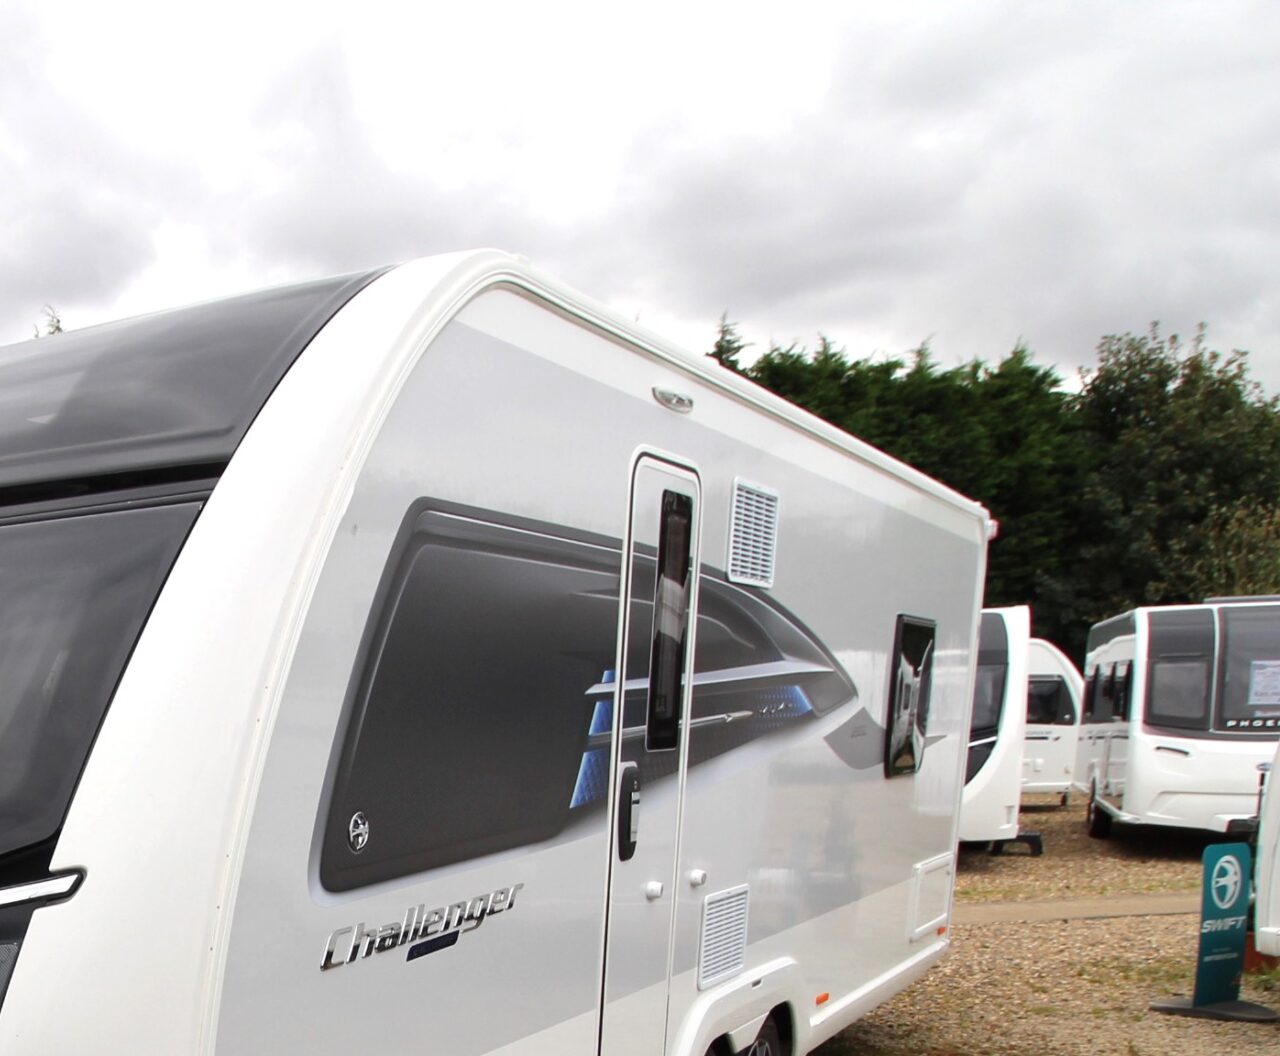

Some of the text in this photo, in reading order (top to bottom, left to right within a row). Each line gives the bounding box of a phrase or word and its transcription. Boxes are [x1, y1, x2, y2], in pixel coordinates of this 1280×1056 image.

[1226, 720, 1280, 728] PHOE
[320, 883, 524, 972] Challenger
[1202, 916, 1247, 933] SWIFT
